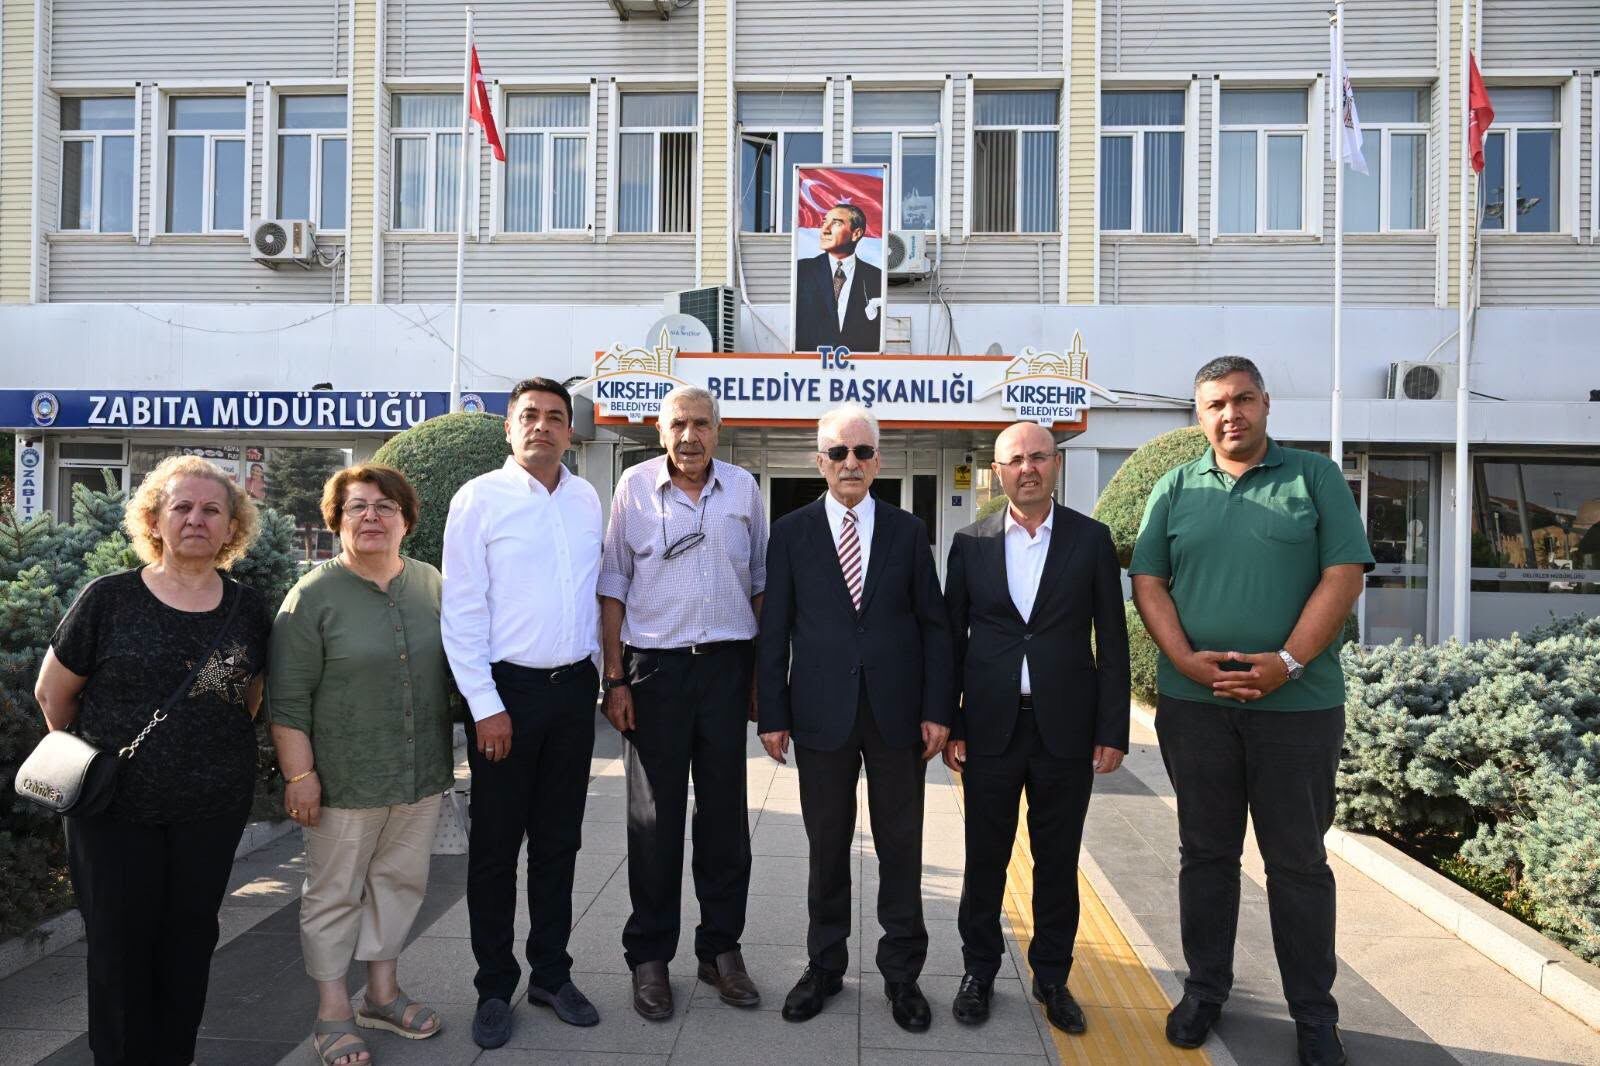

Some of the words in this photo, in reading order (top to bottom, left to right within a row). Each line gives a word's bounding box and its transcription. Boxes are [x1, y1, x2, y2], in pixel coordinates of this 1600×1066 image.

[818, 347, 855, 370] T.C.
[707, 372, 821, 402] BELEDİYE
[829, 372, 973, 408] BAŞKANLIĞI
[88, 396, 202, 425] ZABITA
[212, 391, 426, 428] MÜDÜRLÜĞÜ
